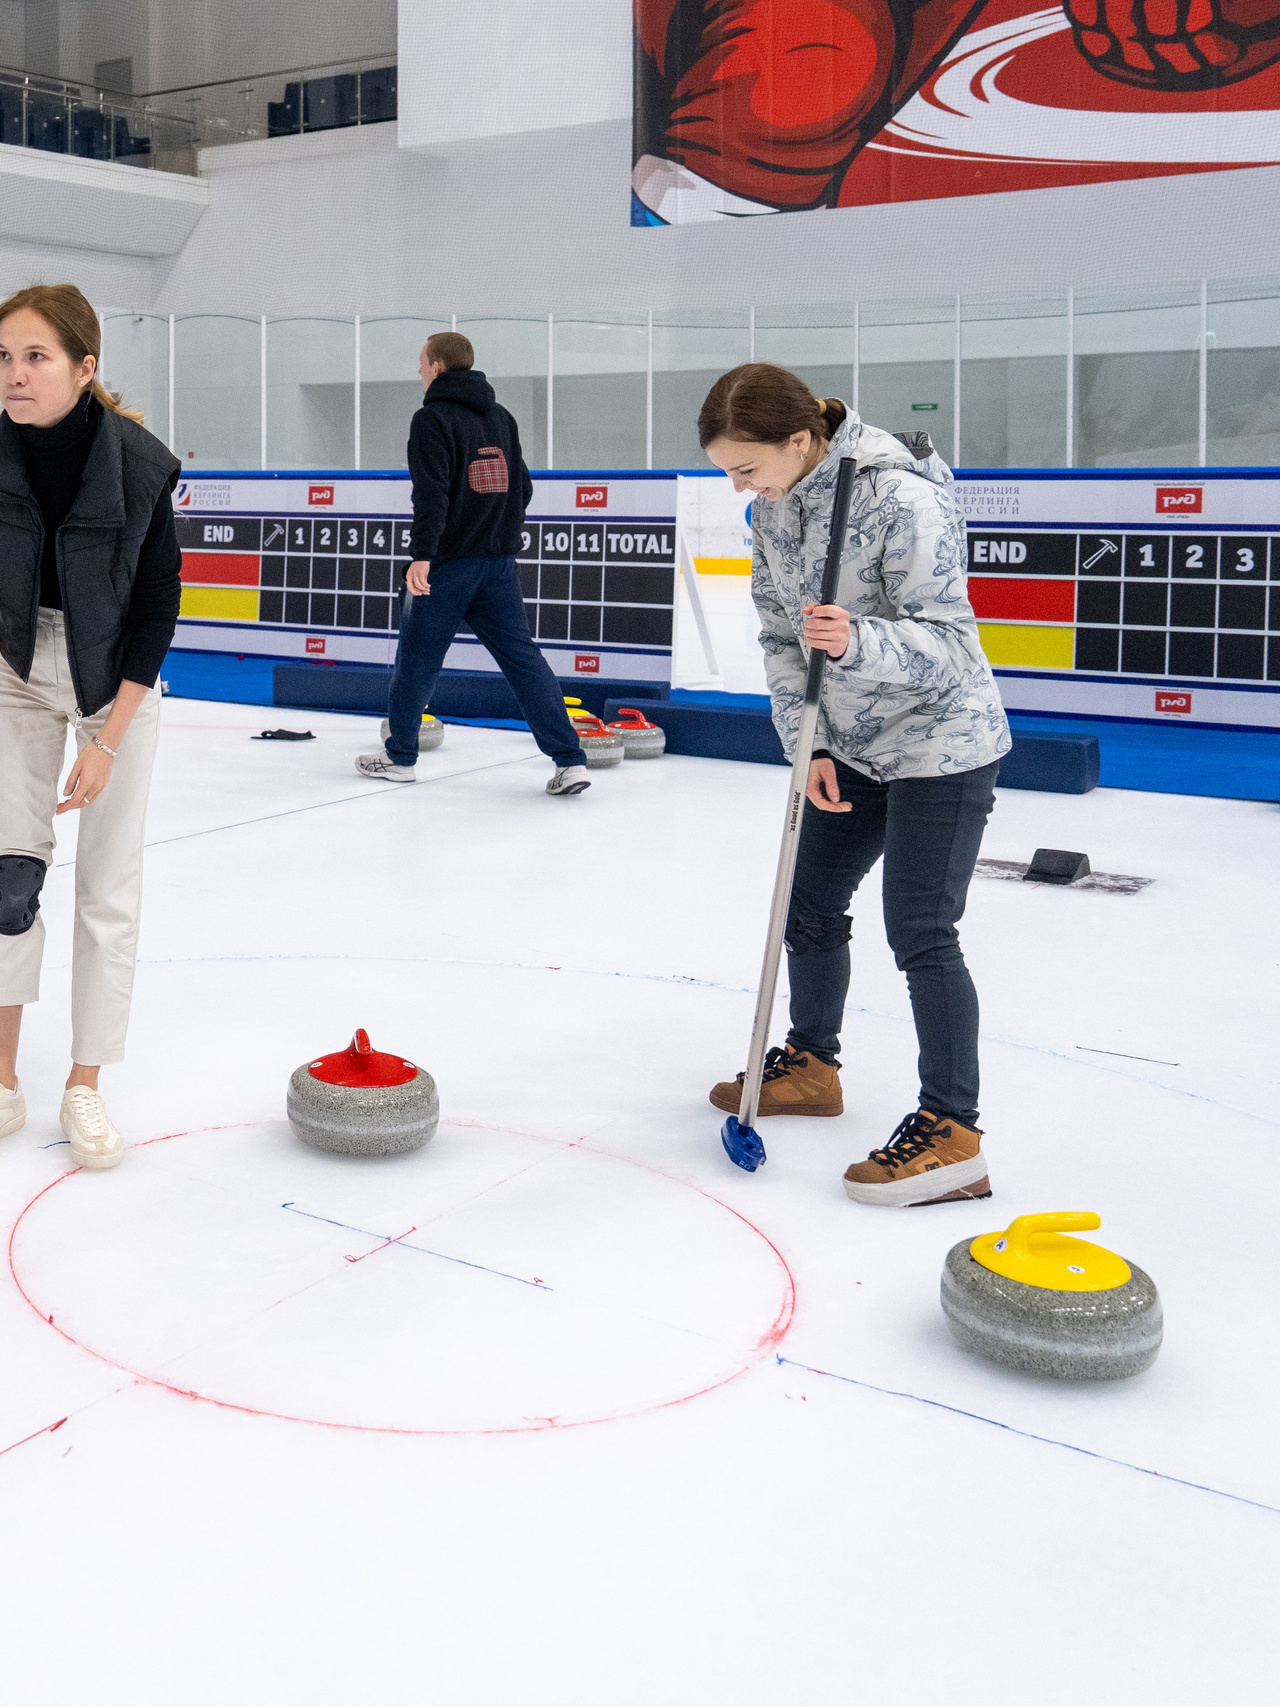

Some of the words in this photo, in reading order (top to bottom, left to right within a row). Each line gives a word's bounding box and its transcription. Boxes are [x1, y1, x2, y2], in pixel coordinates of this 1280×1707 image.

[954, 486, 1020, 495] ФЕДЕРАЦИЯ
[964, 506, 1020, 515] ОССИИ
[203, 525, 235, 543] END
[295, 527, 305, 545] 1
[320, 527, 331, 546] 2
[347, 528, 358, 546] 3
[373, 529, 385, 547] 4
[401, 529, 411, 548] 5
[544, 532, 569, 551] 10
[577, 533, 600, 552] 11
[608, 533, 673, 554] TOTAL
[973, 540, 1027, 564] END
[1139, 544, 1155, 567] 1
[1185, 545, 1204, 568] 2
[1235, 548, 1254, 572] 3
